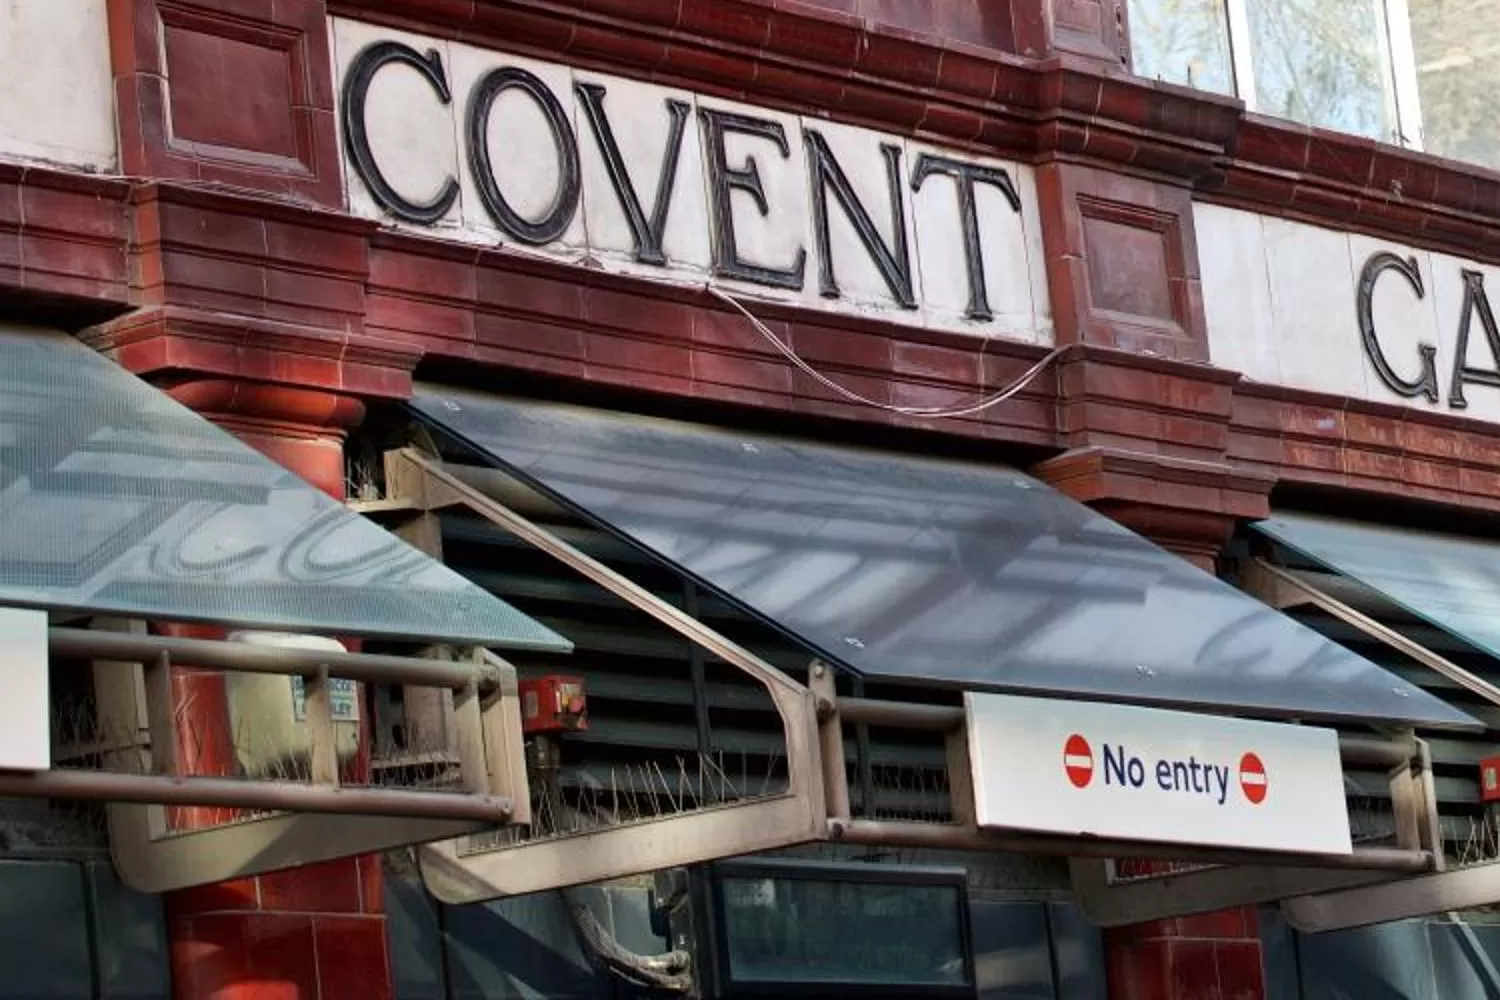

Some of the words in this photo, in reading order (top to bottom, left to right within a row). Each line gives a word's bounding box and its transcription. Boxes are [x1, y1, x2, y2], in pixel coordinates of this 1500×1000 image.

[342, 39, 1022, 322] COVENT
[1103, 744, 1145, 788] No
[1155, 755, 1229, 805] entry
